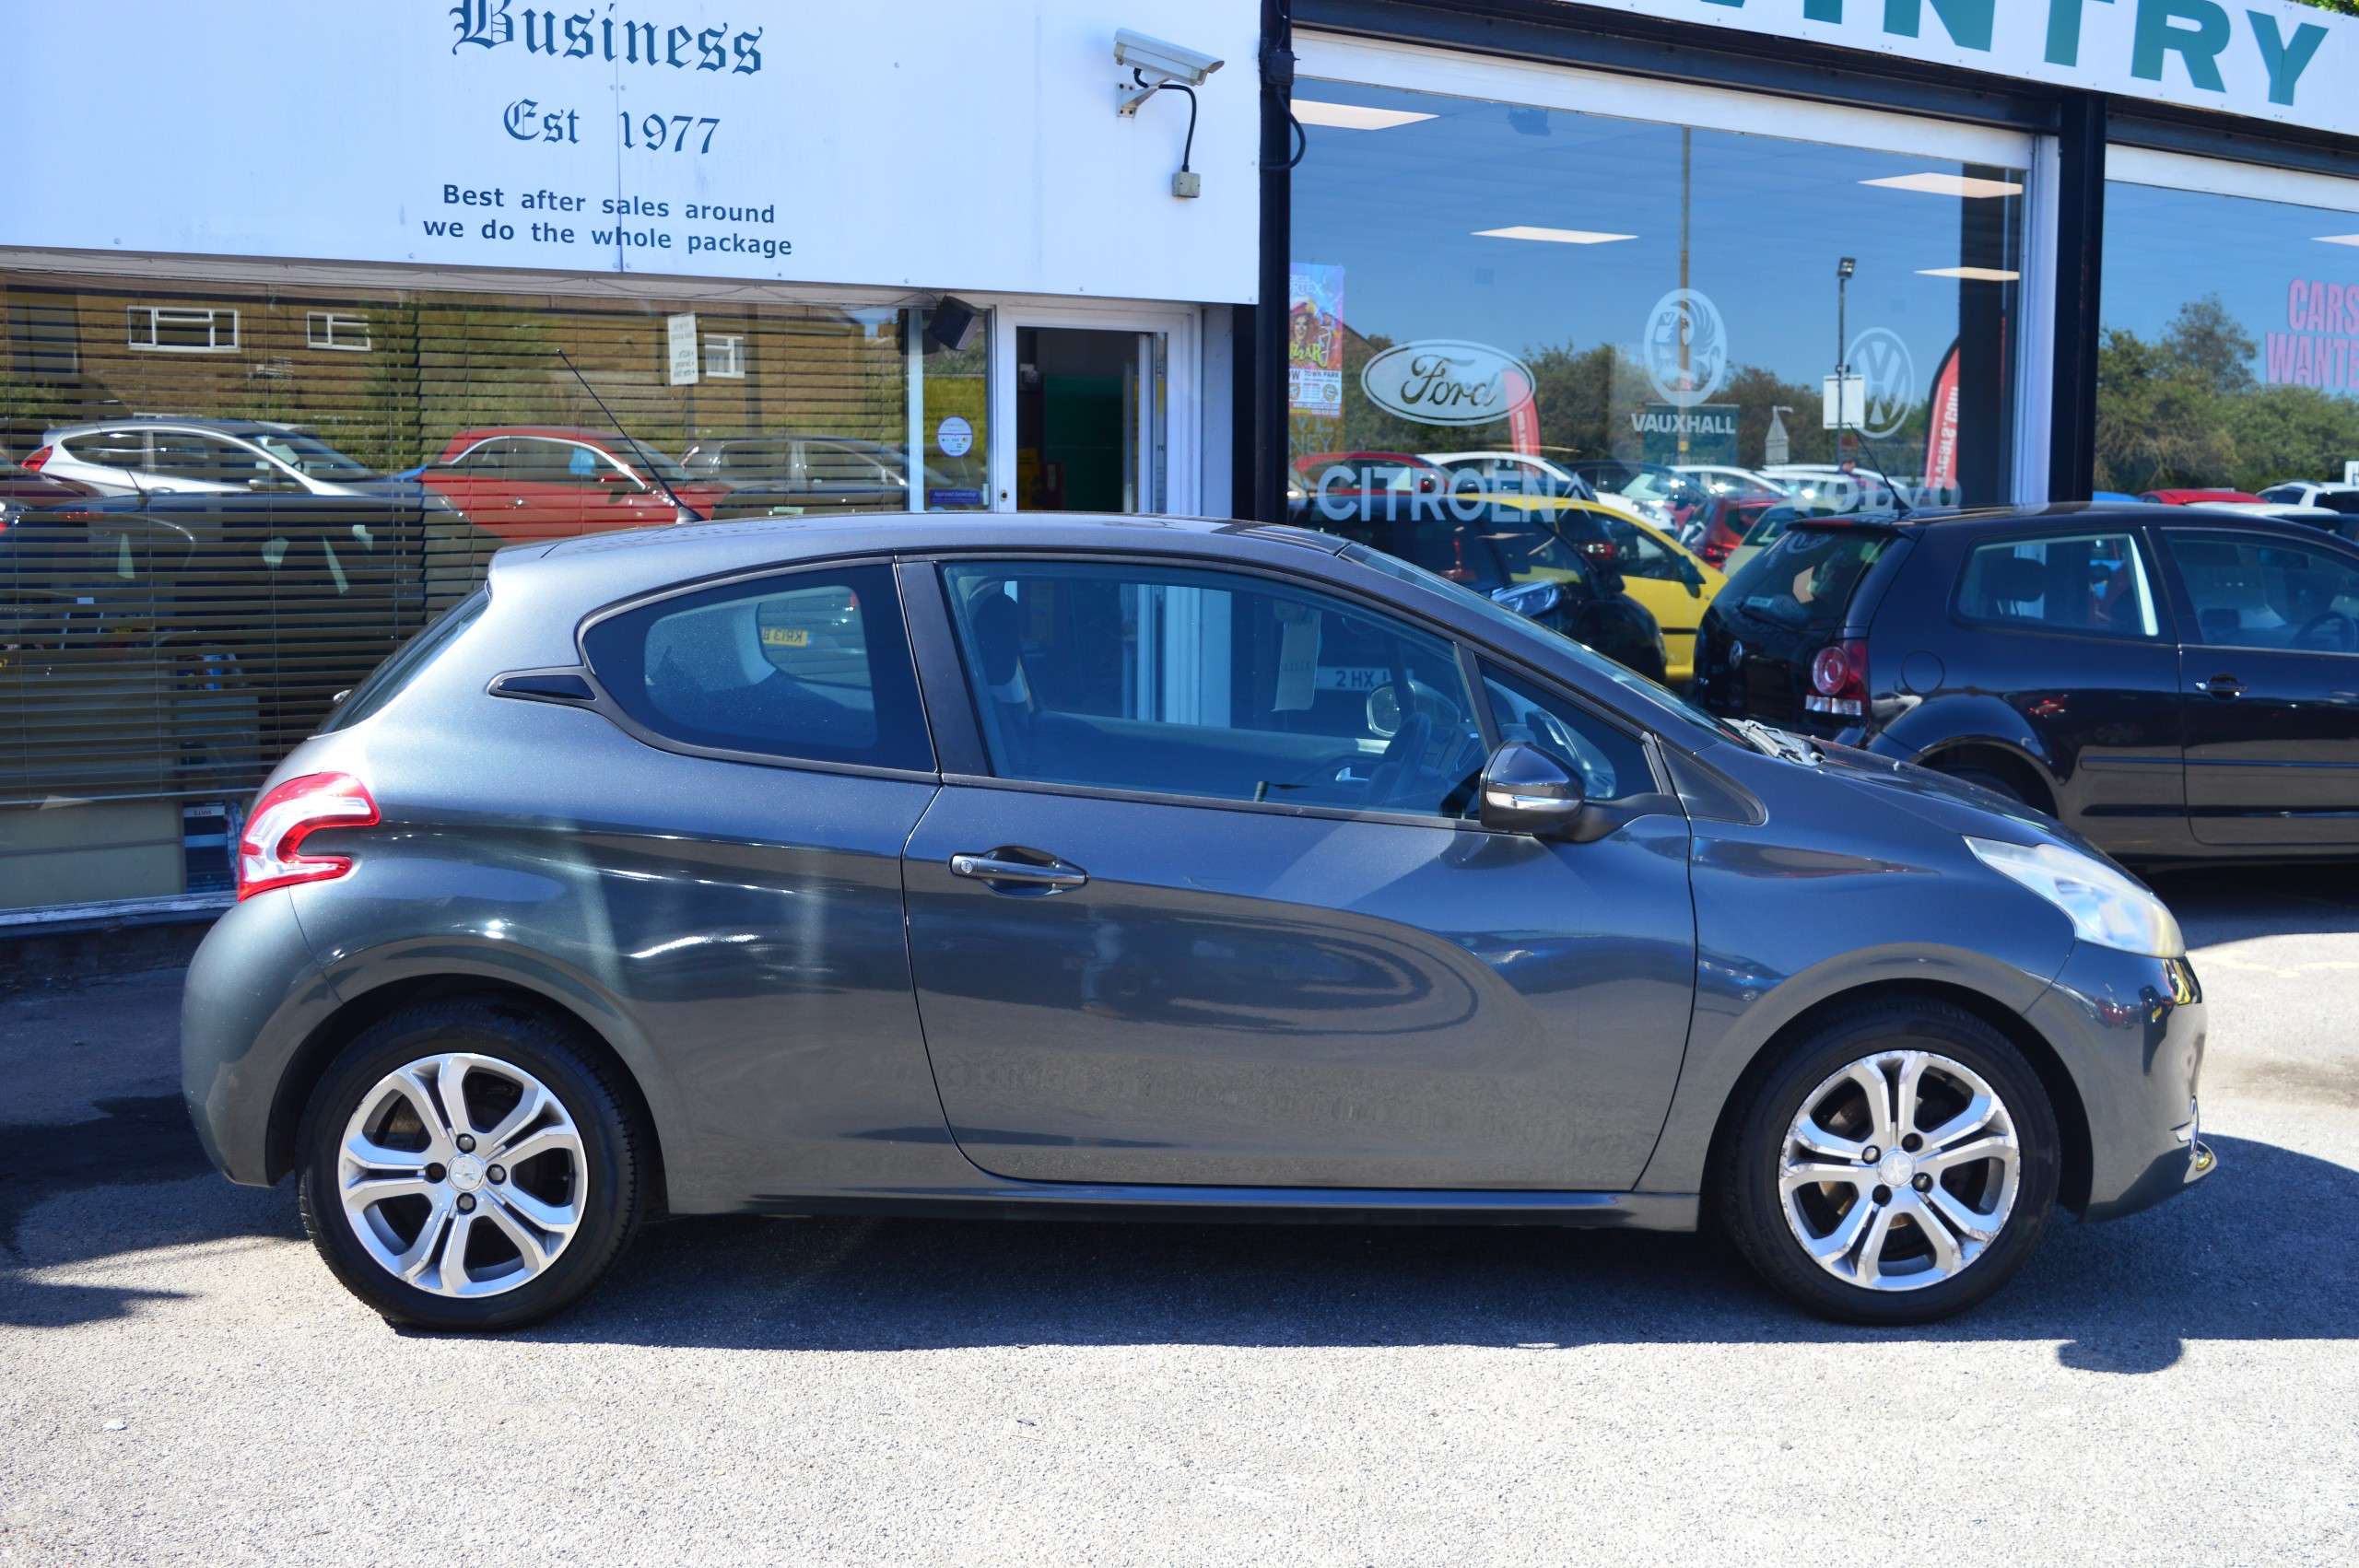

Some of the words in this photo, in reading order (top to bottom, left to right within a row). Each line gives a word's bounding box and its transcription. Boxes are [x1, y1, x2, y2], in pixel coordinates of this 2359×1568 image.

[450, 0, 764, 76] Business
[504, 99, 580, 145] Est
[619, 111, 721, 154] 1977
[443, 184, 505, 207] Best
[521, 189, 586, 212] after
[602, 196, 670, 217] sales
[685, 205, 775, 224] around
[423, 219, 464, 238] we
[481, 219, 515, 240] do
[531, 222, 576, 243] the
[592, 227, 672, 249] whole
[687, 233, 792, 259] package
[2288, 279, 2359, 335] CARS
[1400, 354, 1499, 407] Ford
[1631, 413, 1736, 435] VAUXHALL
